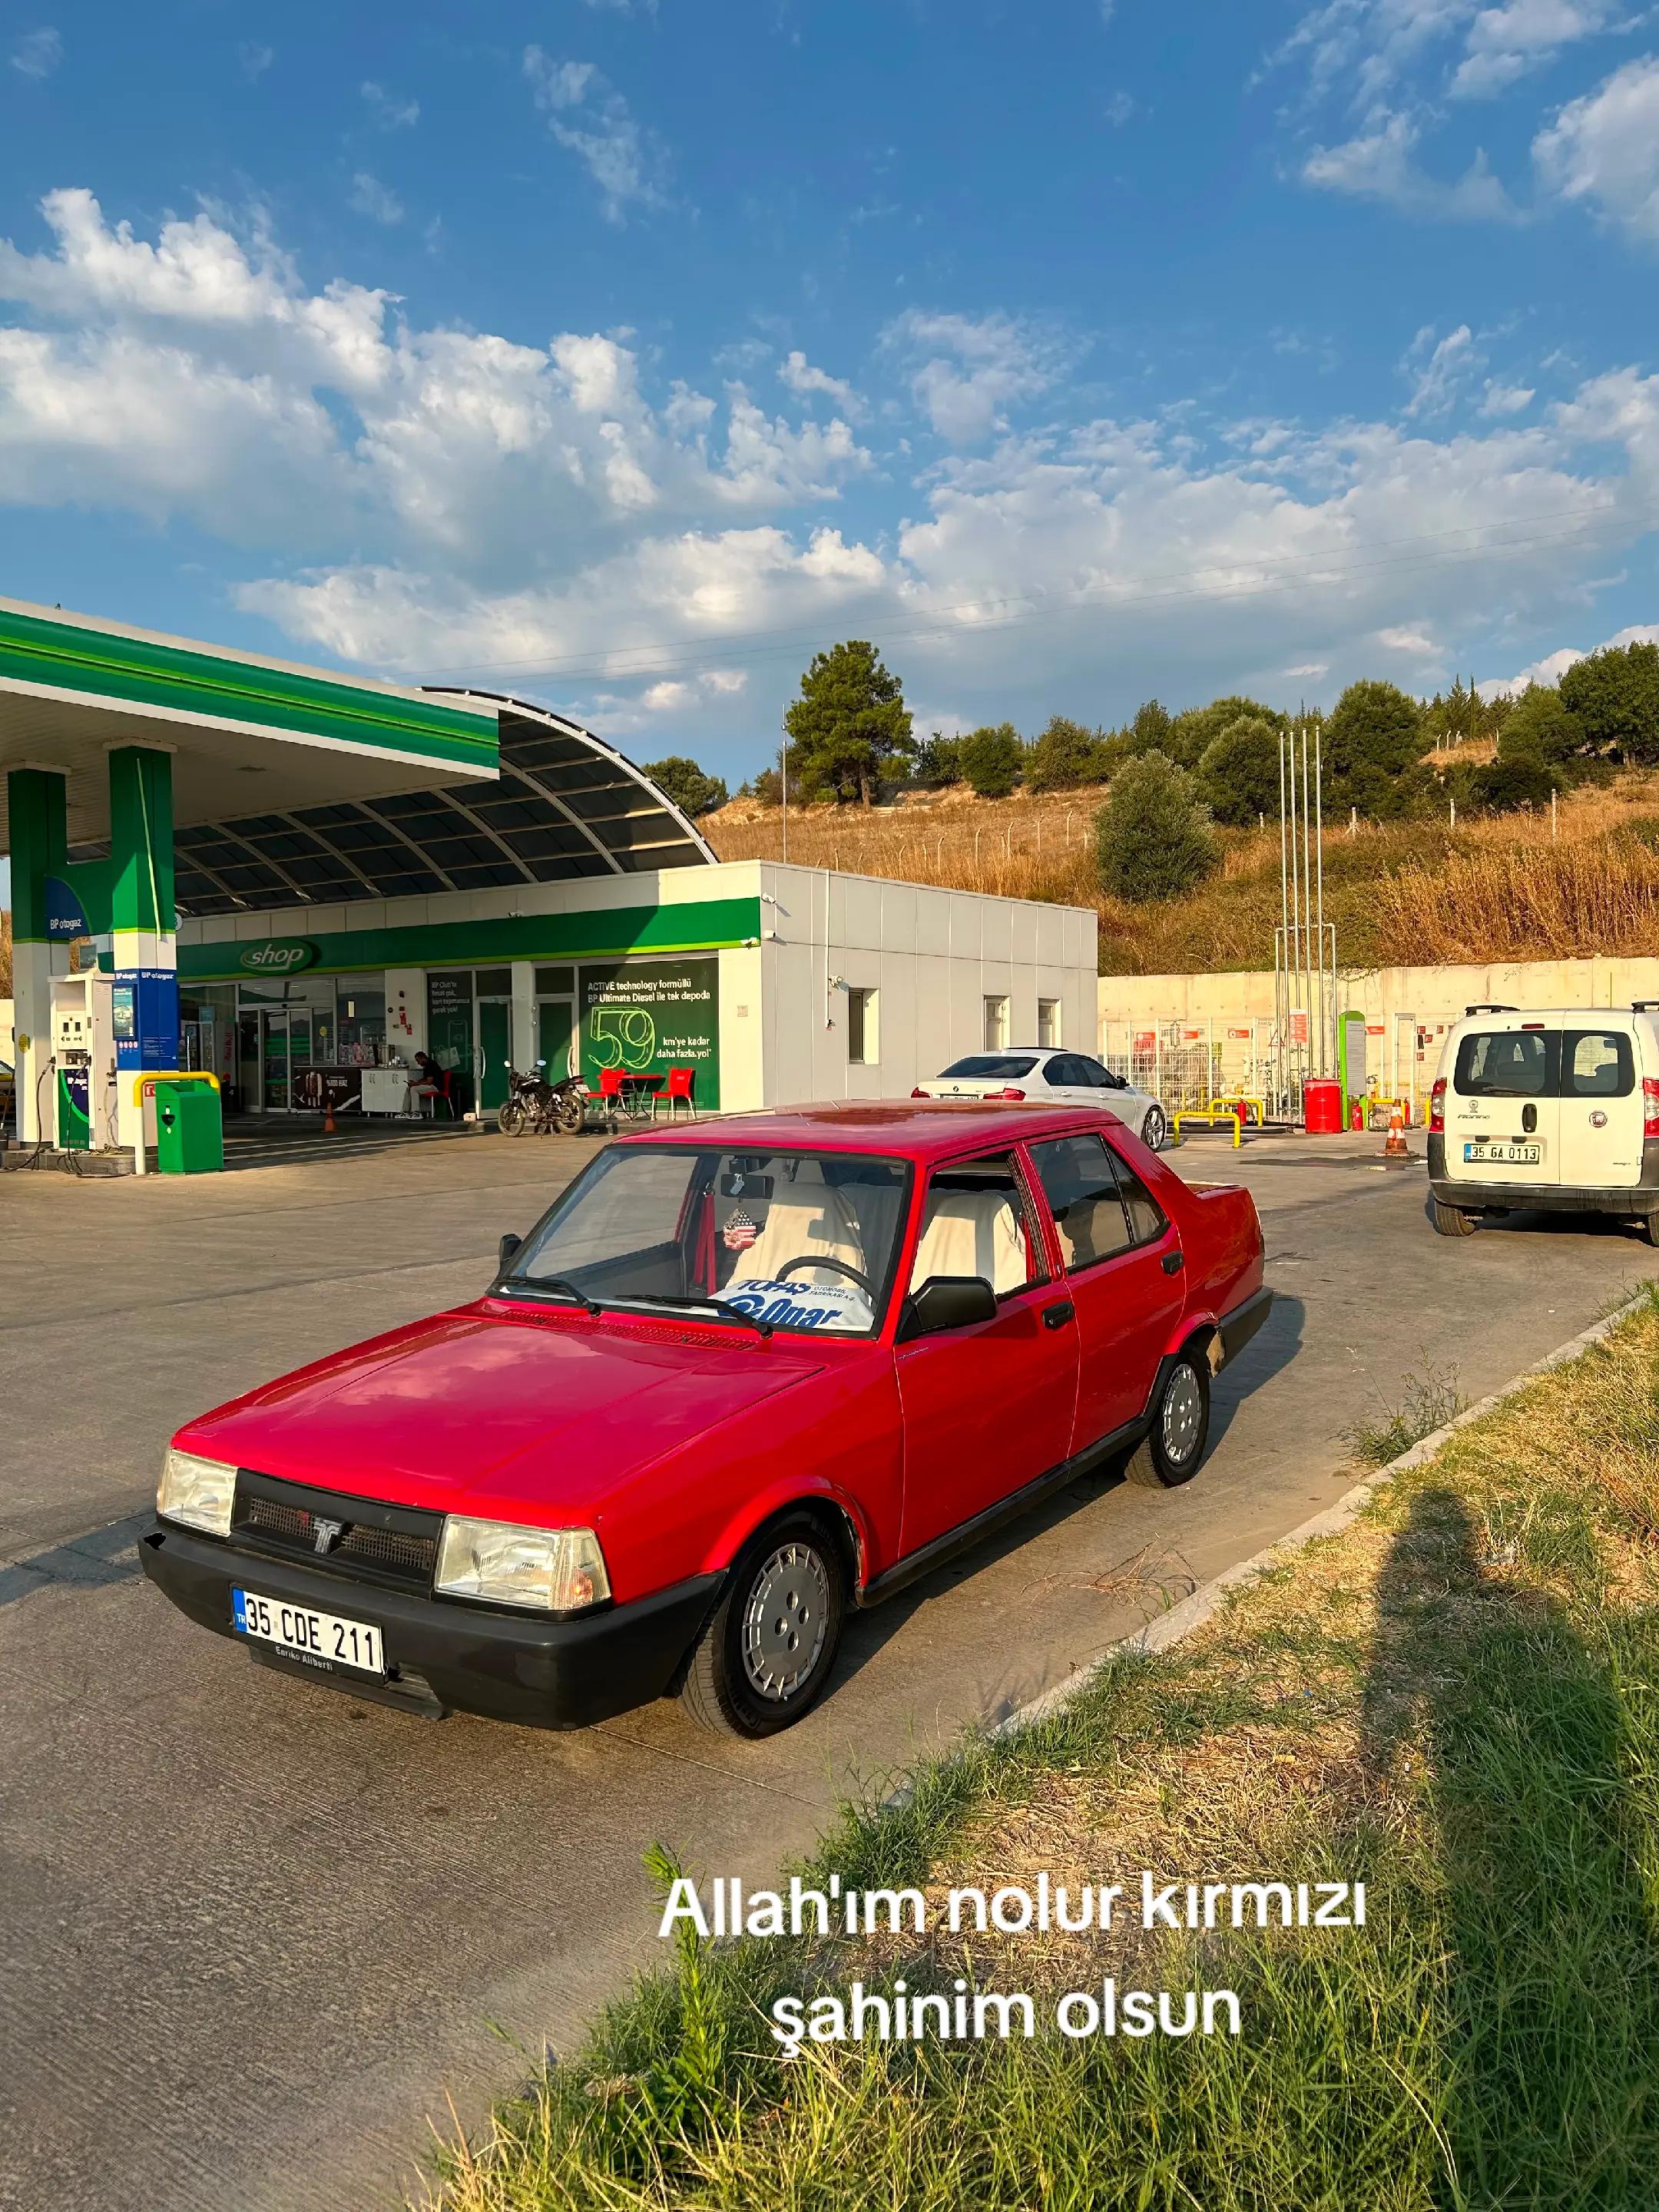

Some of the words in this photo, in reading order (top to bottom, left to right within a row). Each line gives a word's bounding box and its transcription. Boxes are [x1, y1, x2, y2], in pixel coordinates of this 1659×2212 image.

[50, 919, 58, 929] BP
[60, 919, 81, 930] otogaz
[252, 944, 304, 970] shop
[588, 982, 615, 992] ACTIVE
[616, 980, 657, 992] technology
[659, 979, 691, 989] formüllü
[588, 995, 598, 1003] BP
[599, 993, 631, 1003] Ultimate
[632, 992, 655, 1002] Diesel
[657, 992, 665, 1001] ile
[667, 992, 680, 1001] tek
[681, 990, 710, 1002] depoda
[663, 1037, 686, 1048] km'ye
[687, 1036, 710, 1046] kadar
[657, 1049, 676, 1058] daha
[1472, 1147, 1485, 1157] 35
[1491, 1147, 1503, 1159] GA
[237, 1613, 247, 1624] TR
[246, 1598, 271, 1636] 35
[281, 1608, 322, 1652] CDE
[333, 1623, 374, 1667] 211
